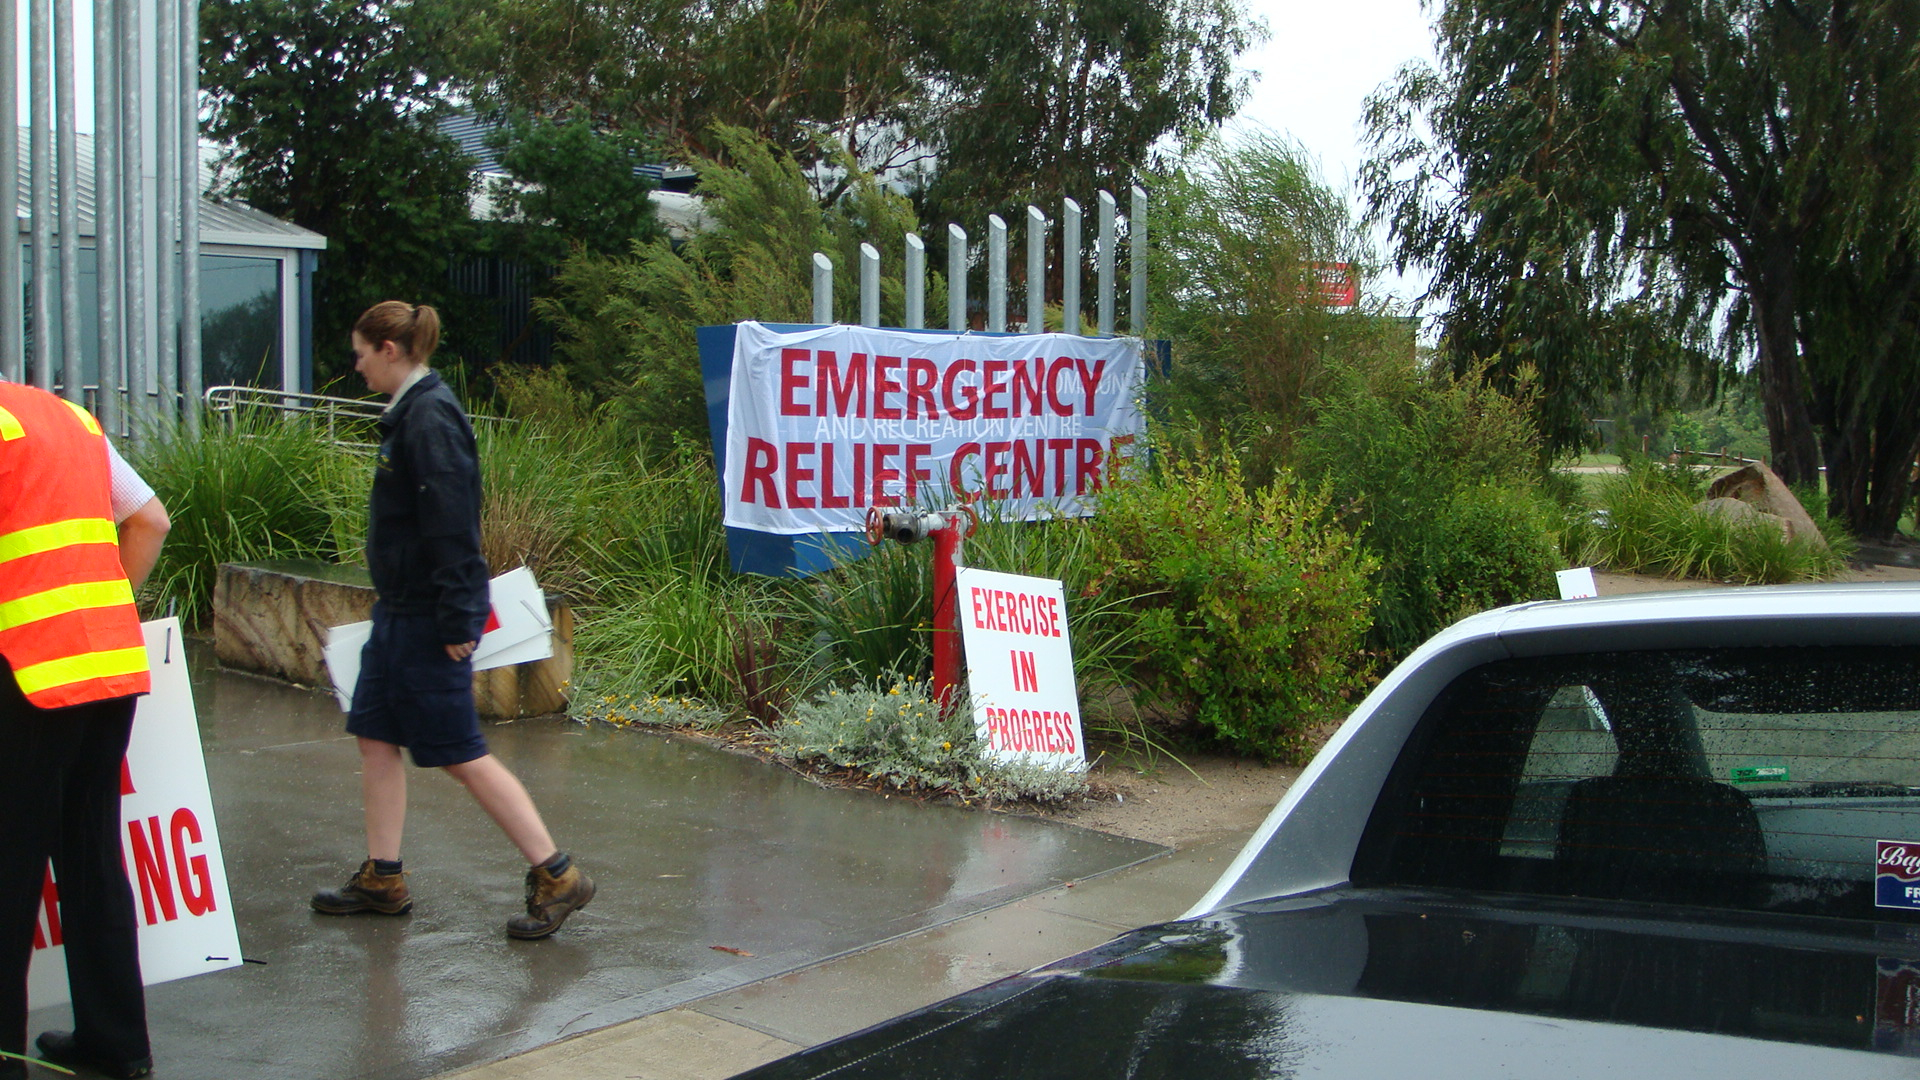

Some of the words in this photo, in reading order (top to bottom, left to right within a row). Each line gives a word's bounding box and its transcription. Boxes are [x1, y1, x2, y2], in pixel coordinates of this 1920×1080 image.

[781, 348, 1106, 421] EMERGENCY
[814, 414, 866, 440] AND
[740, 436, 932, 509] RELIEF
[971, 587, 1061, 638] EXERCISE
[1010, 650, 1039, 693] IN
[986, 707, 1076, 754] PROGRESS
